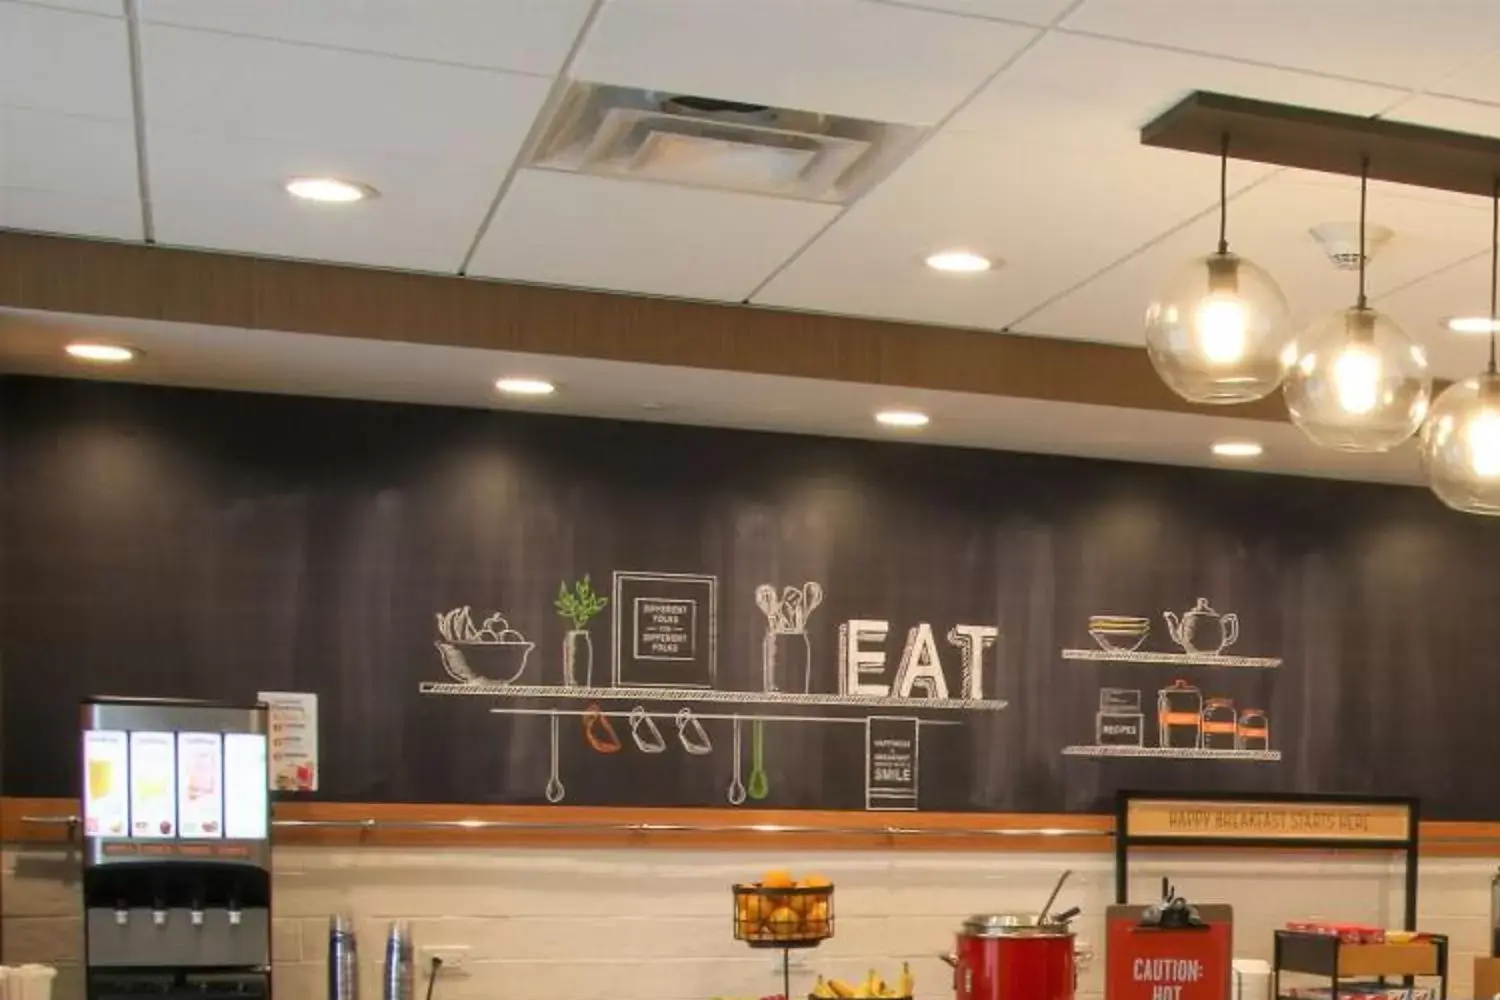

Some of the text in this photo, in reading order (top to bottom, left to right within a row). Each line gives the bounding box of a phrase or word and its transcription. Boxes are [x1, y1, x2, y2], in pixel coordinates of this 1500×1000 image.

[838, 618, 999, 700] EAT
[874, 768, 912, 781] SMILE
[1169, 809, 1210, 830] HAPPY
[1214, 810, 1287, 831] BREAKFAST
[1291, 811, 1335, 832] STARTS
[1133, 957, 1204, 982] CAUTION:
